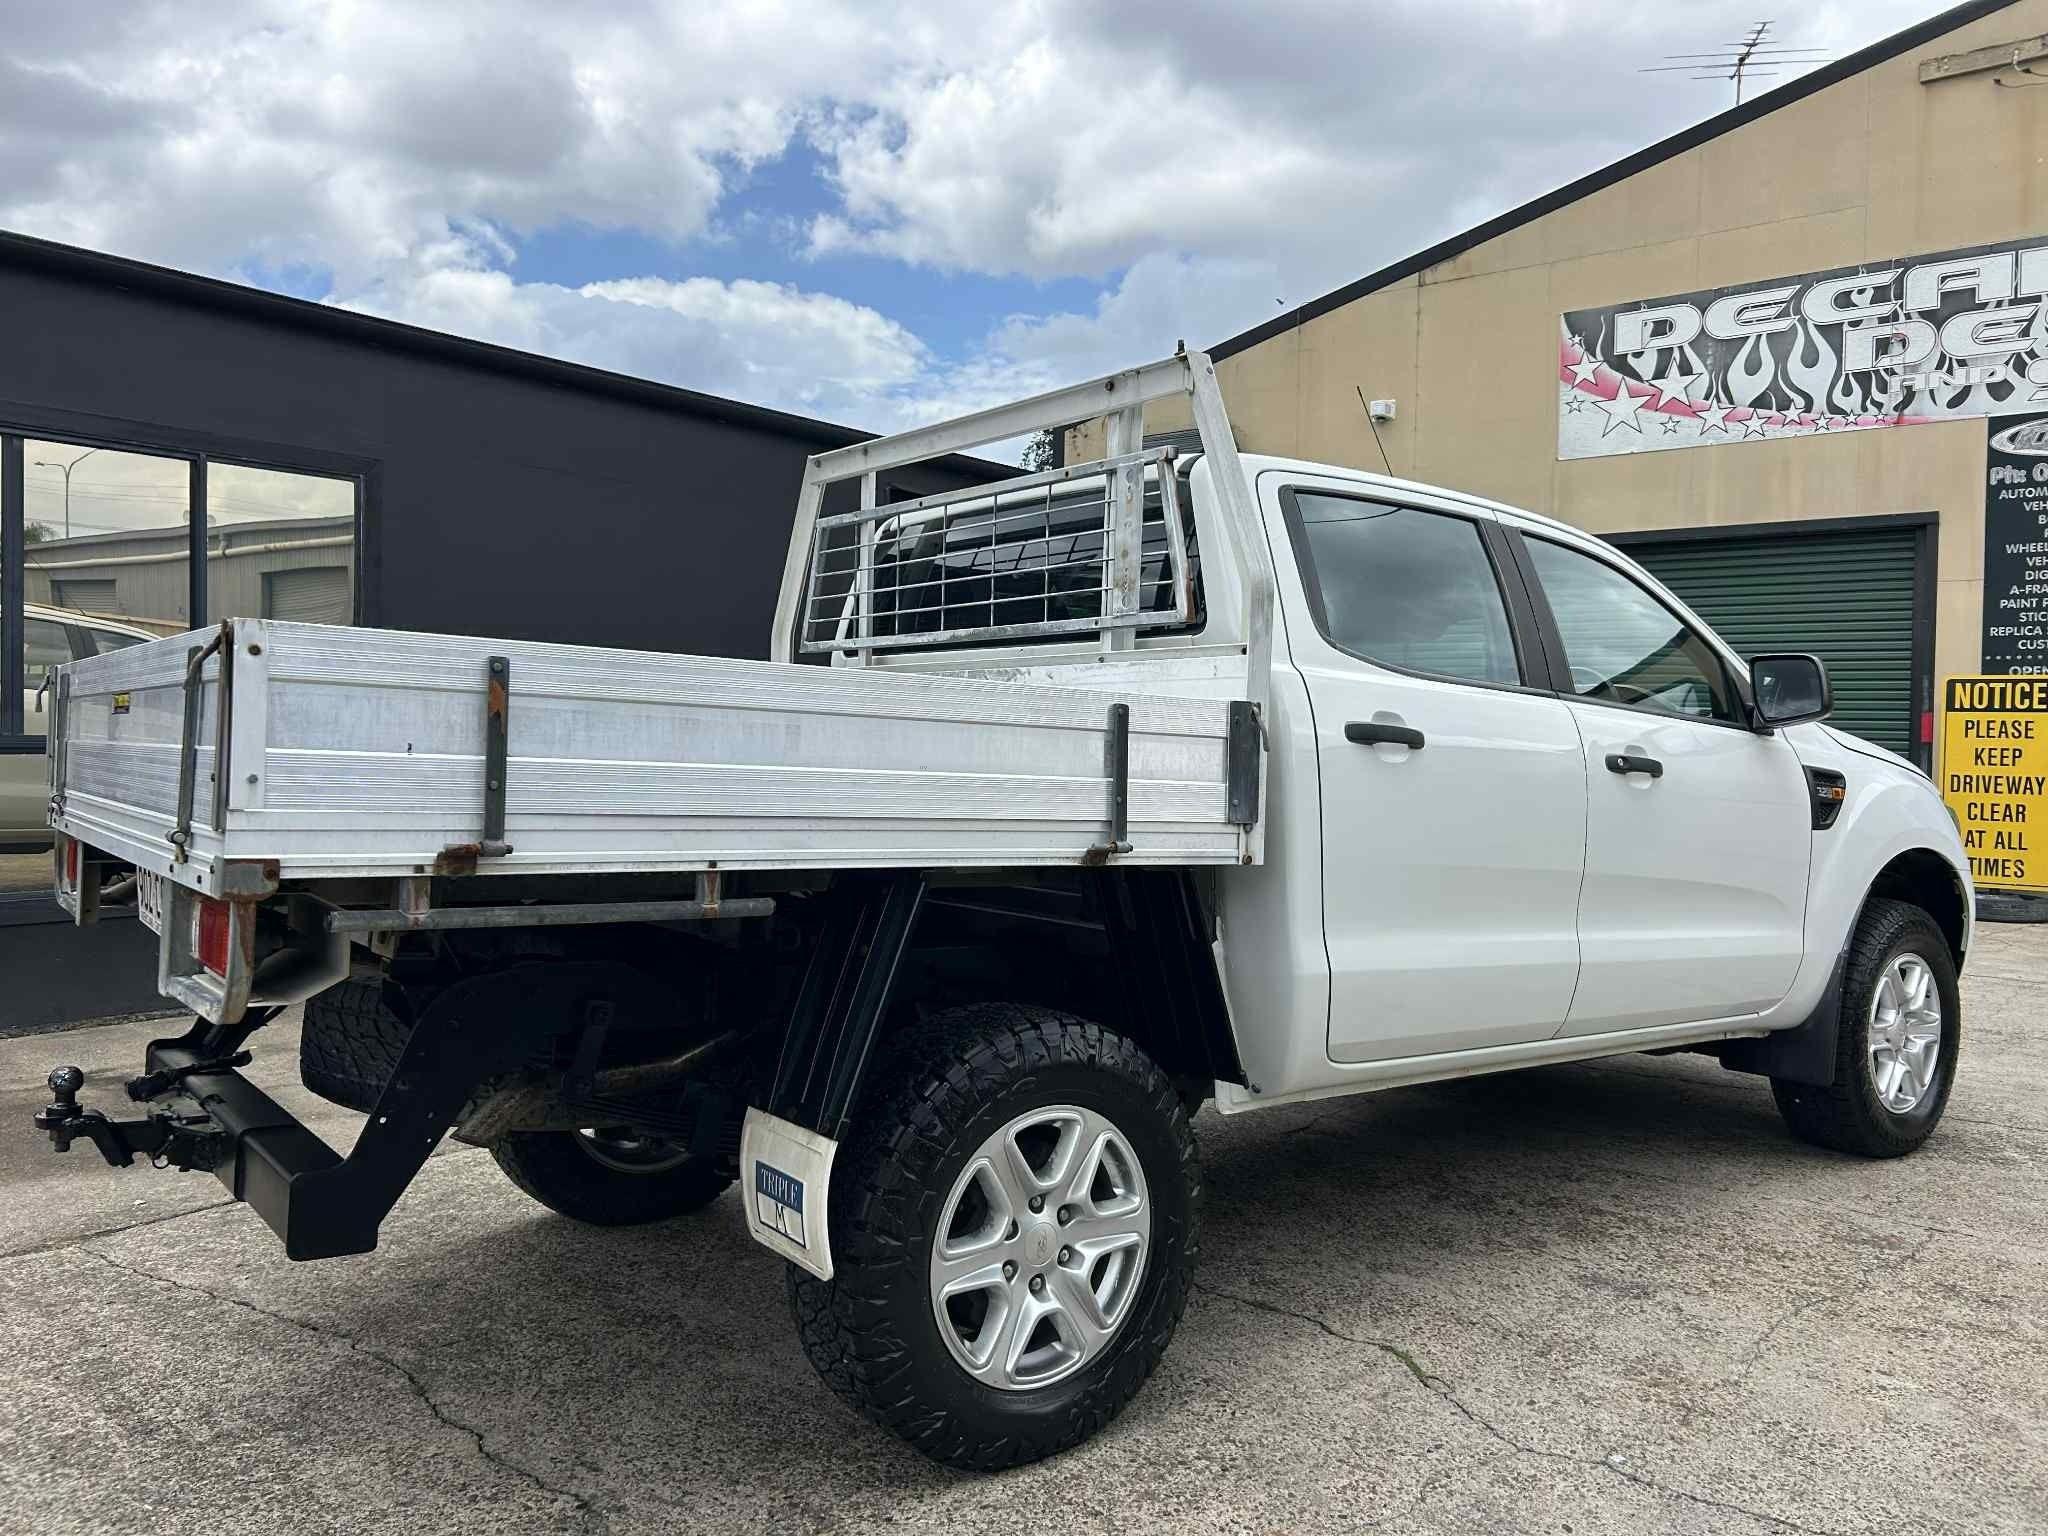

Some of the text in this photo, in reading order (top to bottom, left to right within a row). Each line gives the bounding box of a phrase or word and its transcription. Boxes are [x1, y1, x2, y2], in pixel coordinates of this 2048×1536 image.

[1844, 303, 2048, 374] DE
[1889, 364, 2007, 394] AND
[2000, 598, 2039, 609] PAINT
[1990, 626, 2042, 637] REPLICA
[1954, 682, 2047, 710] NOTICE
[1964, 719, 2035, 740] PLEASE
[1974, 747, 2023, 767] KEEP
[1950, 774, 2046, 795] DRIVEWAY
[1967, 802, 2026, 822] CLEAR
[1964, 829, 2028, 850] AT ALL
[1967, 857, 2024, 878] TIMES
[760, 1168, 799, 1209] TRIPLE
